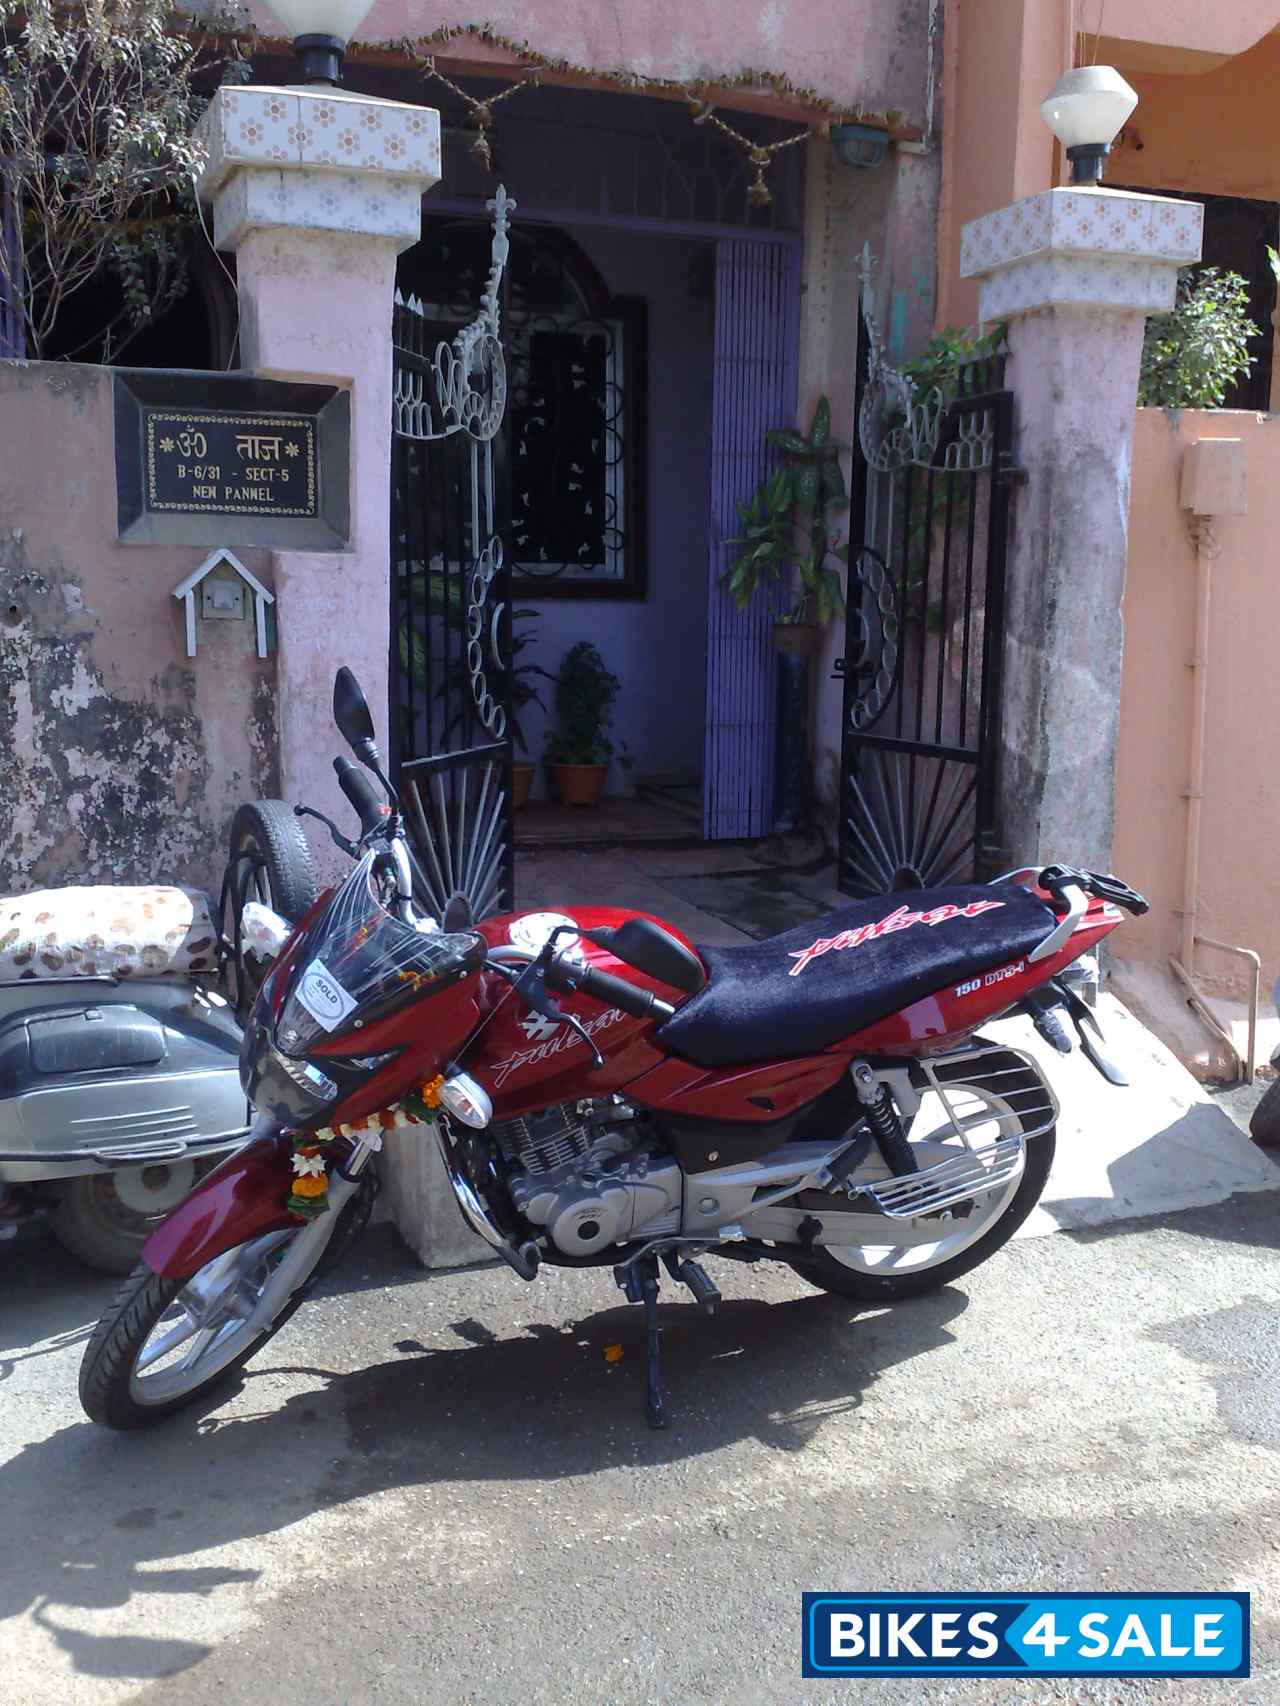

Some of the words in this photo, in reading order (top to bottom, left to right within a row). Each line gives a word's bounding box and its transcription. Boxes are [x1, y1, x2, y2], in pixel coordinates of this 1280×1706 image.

[235, 434, 283, 461] ताज
[178, 464, 221, 481] B-6/31
[246, 468, 289, 482] SECT-5
[315, 979, 338, 1004] SOLD
[954, 978, 981, 998] 150
